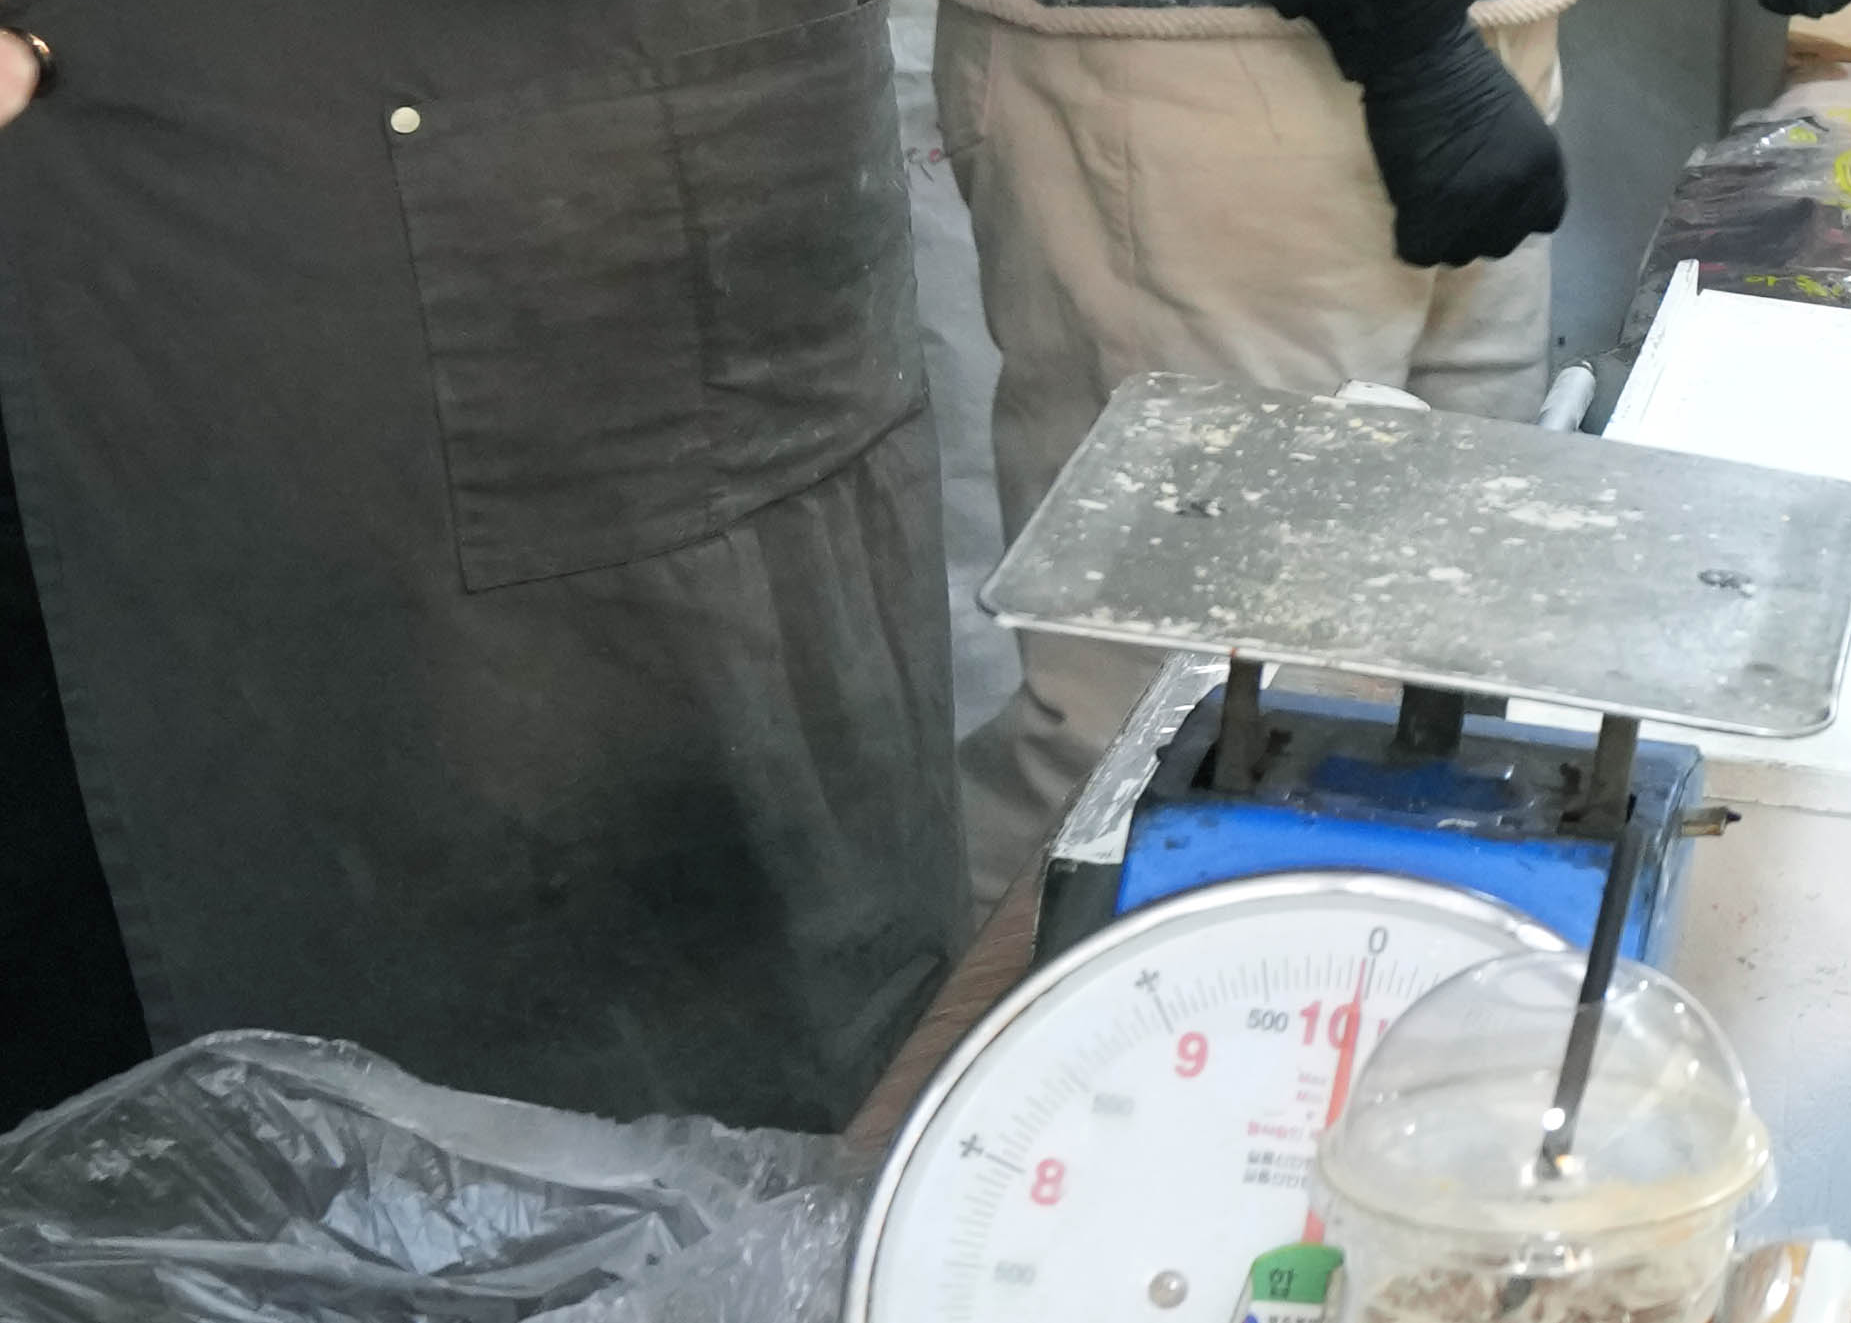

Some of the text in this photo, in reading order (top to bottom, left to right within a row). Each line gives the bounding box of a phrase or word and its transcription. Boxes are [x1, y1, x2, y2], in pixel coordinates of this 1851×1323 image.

[1368, 925, 1389, 955] 0
[1247, 1008, 1289, 1033] 500
[1174, 1030, 1209, 1079] 9
[1029, 1157, 1067, 1207] 8
